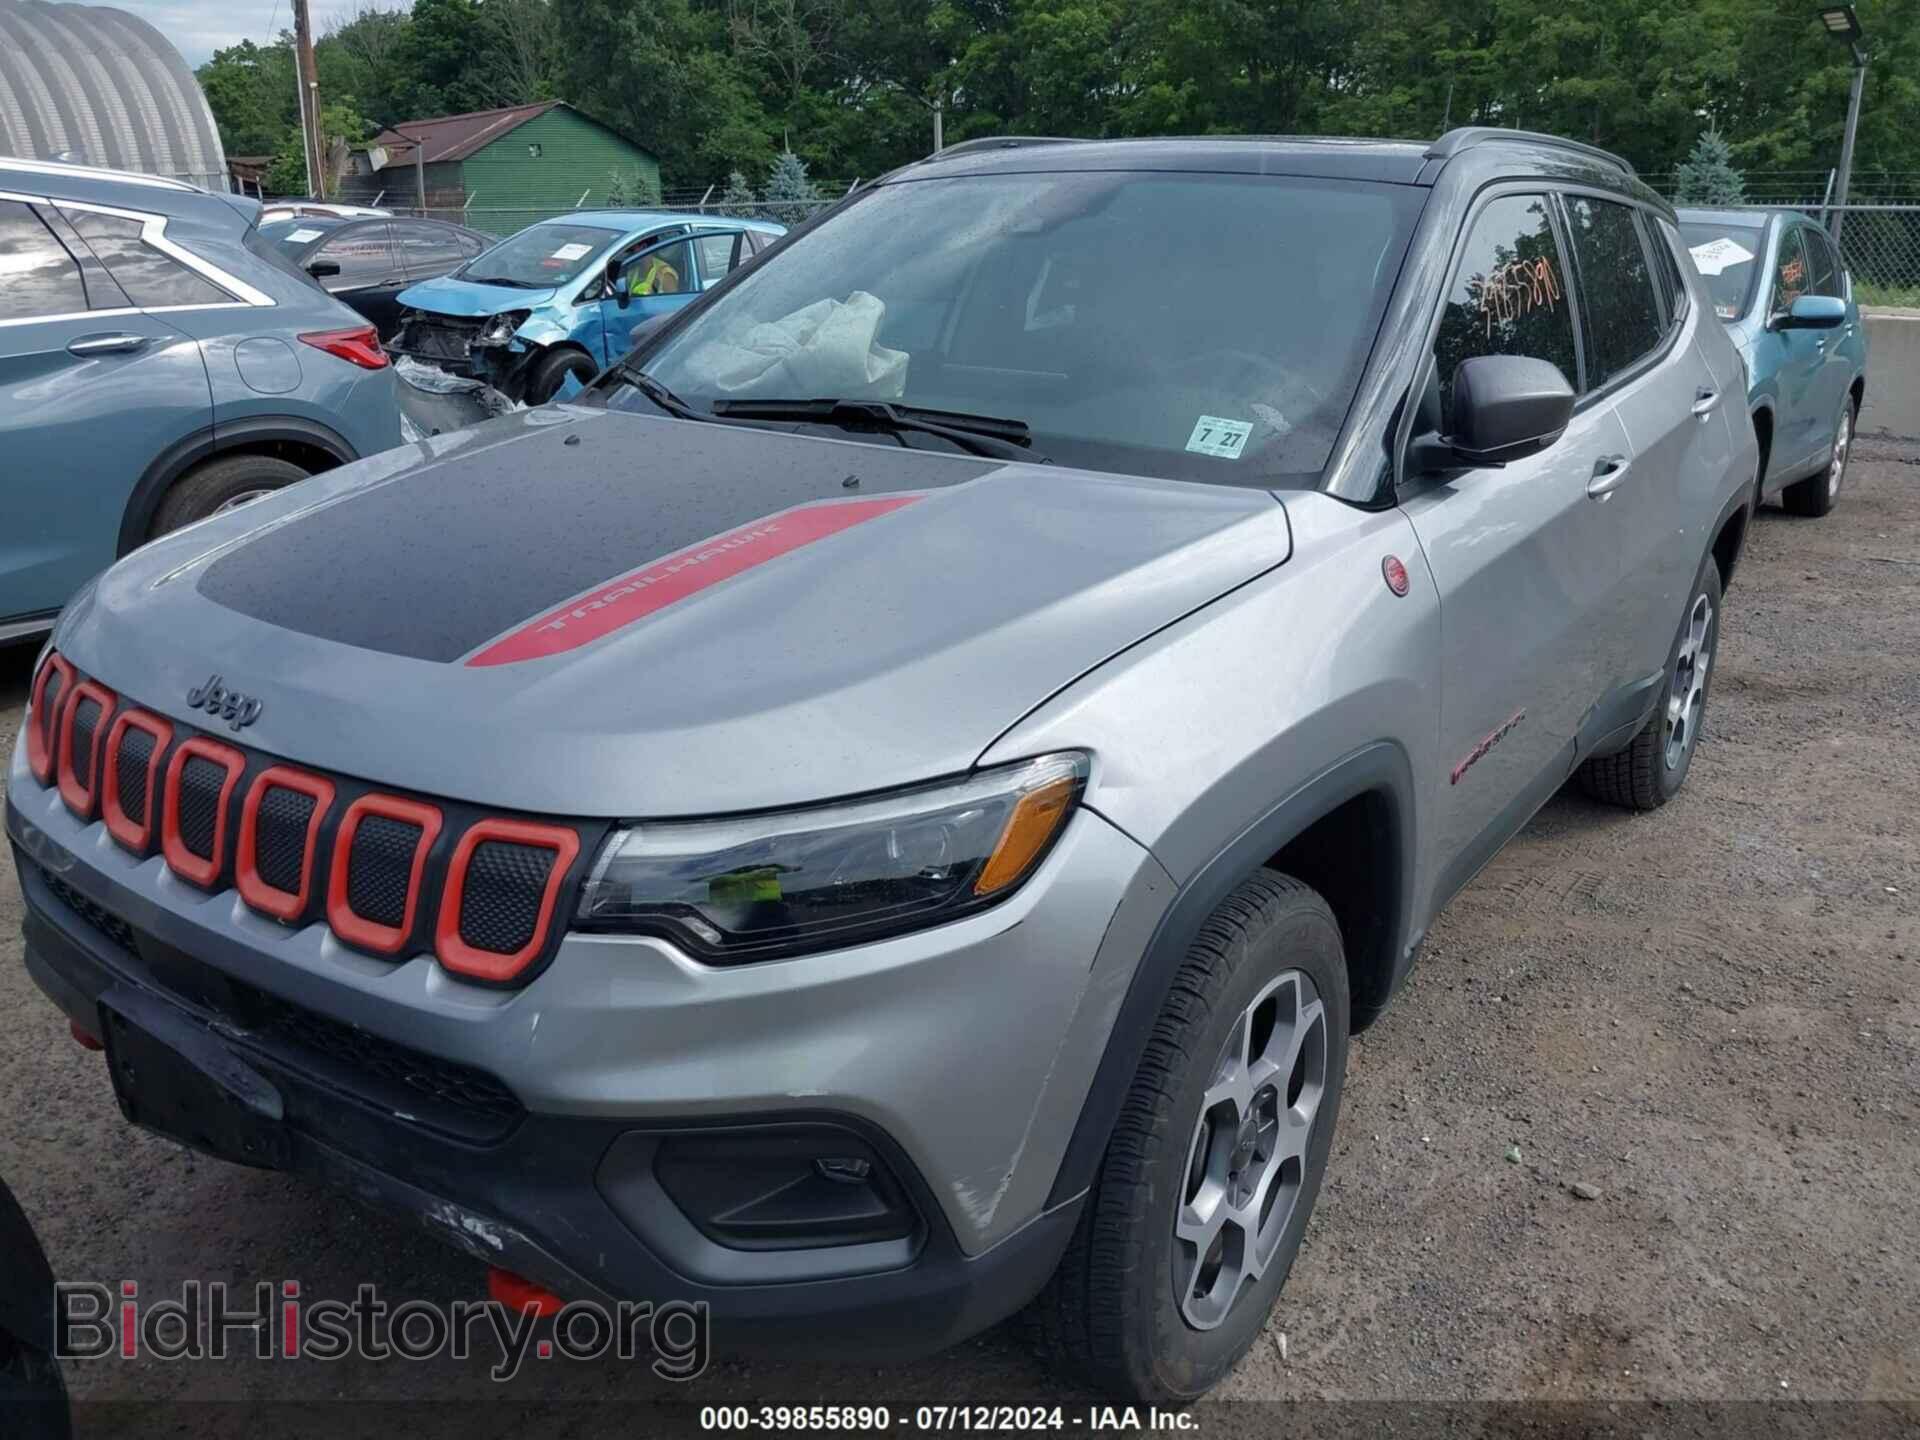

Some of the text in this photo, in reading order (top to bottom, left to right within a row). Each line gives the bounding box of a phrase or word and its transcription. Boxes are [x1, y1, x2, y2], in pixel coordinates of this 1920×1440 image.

[1200, 428, 1242, 447] 7 27
[535, 523, 781, 633] TRAILHAWK
[186, 673, 264, 732] Jeep
